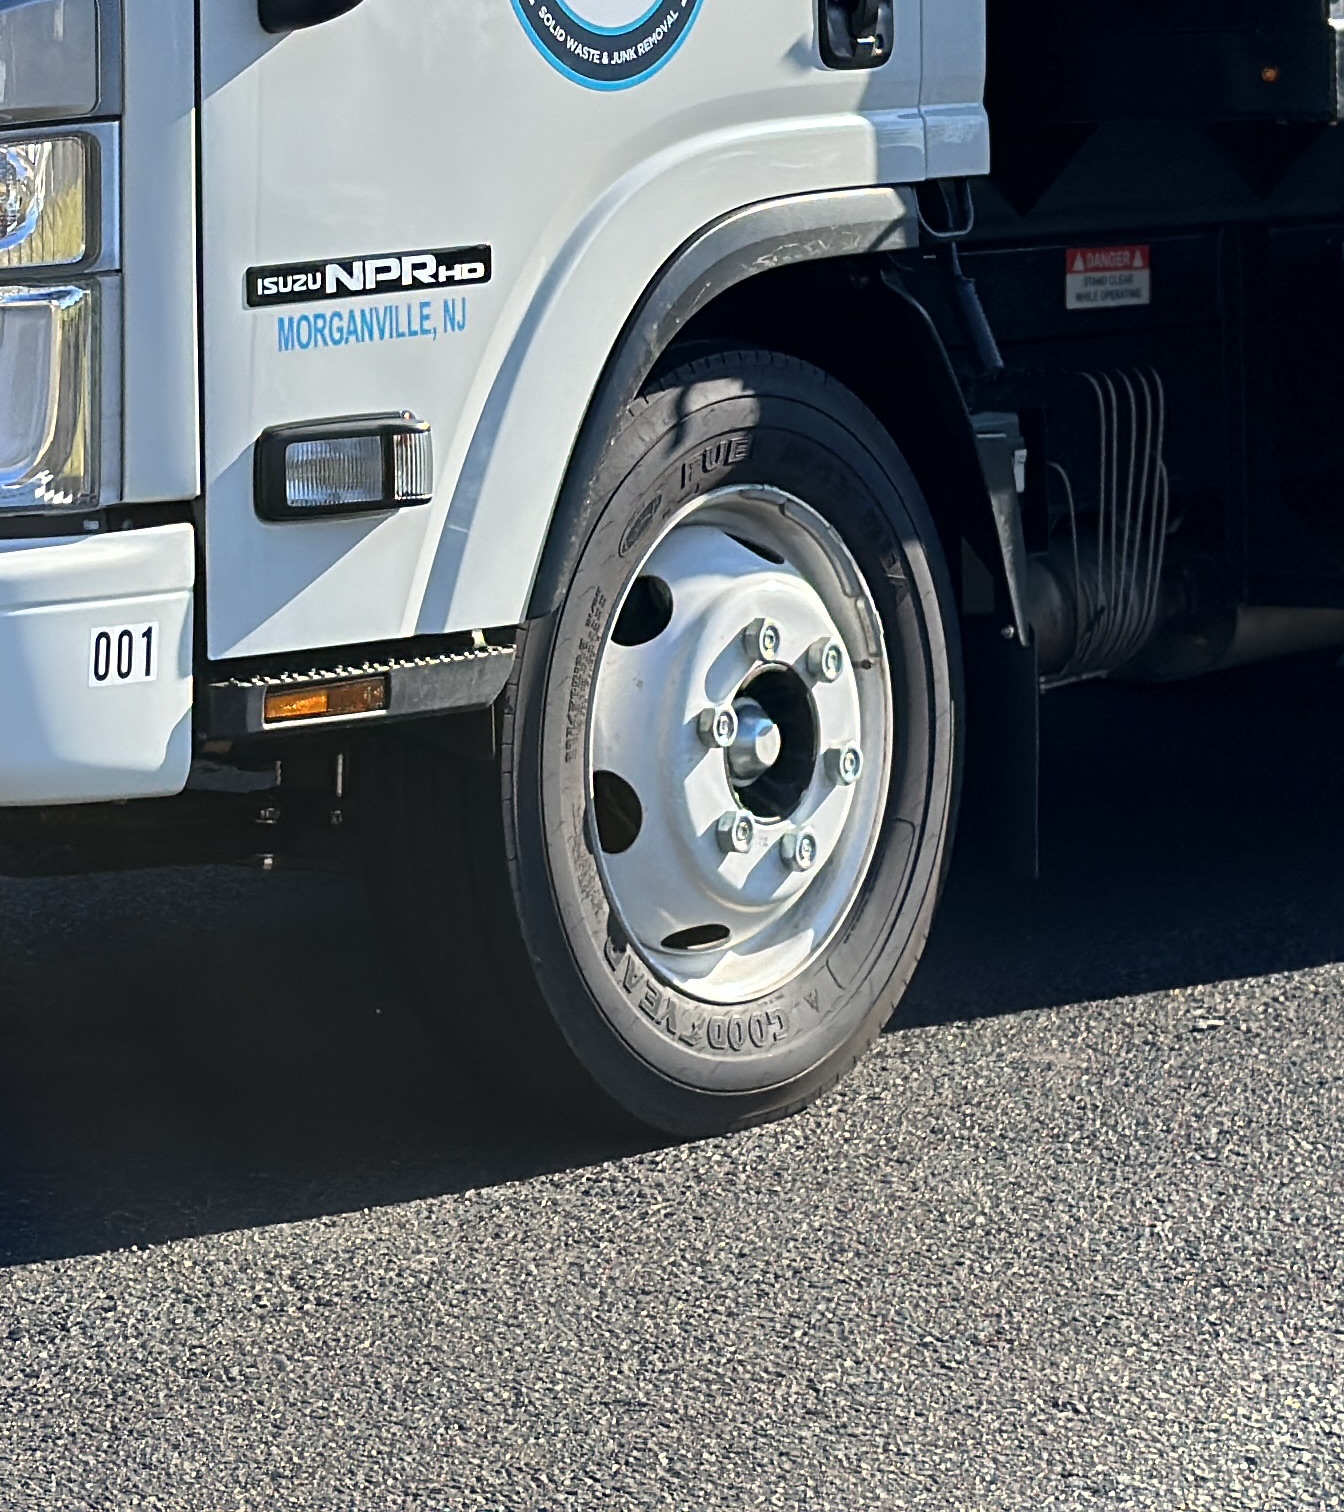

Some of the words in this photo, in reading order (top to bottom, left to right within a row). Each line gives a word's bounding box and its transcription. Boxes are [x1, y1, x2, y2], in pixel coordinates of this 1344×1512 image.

[538, 6, 565, 42] SOLID
[566, 36, 601, 64] WASTE
[601, 51, 609, 65] &
[611, 46, 637, 65] JUNK
[637, 9, 679, 56] REMOVAL
[257, 271, 322, 296] ISUZU
[325, 254, 437, 294] NPR
[438, 261, 485, 283] HD
[1086, 251, 1131, 268] DANGER
[277, 301, 438, 352] MORGANVILLE,
[442, 297, 467, 333] NJ
[94, 626, 153, 681] 001
